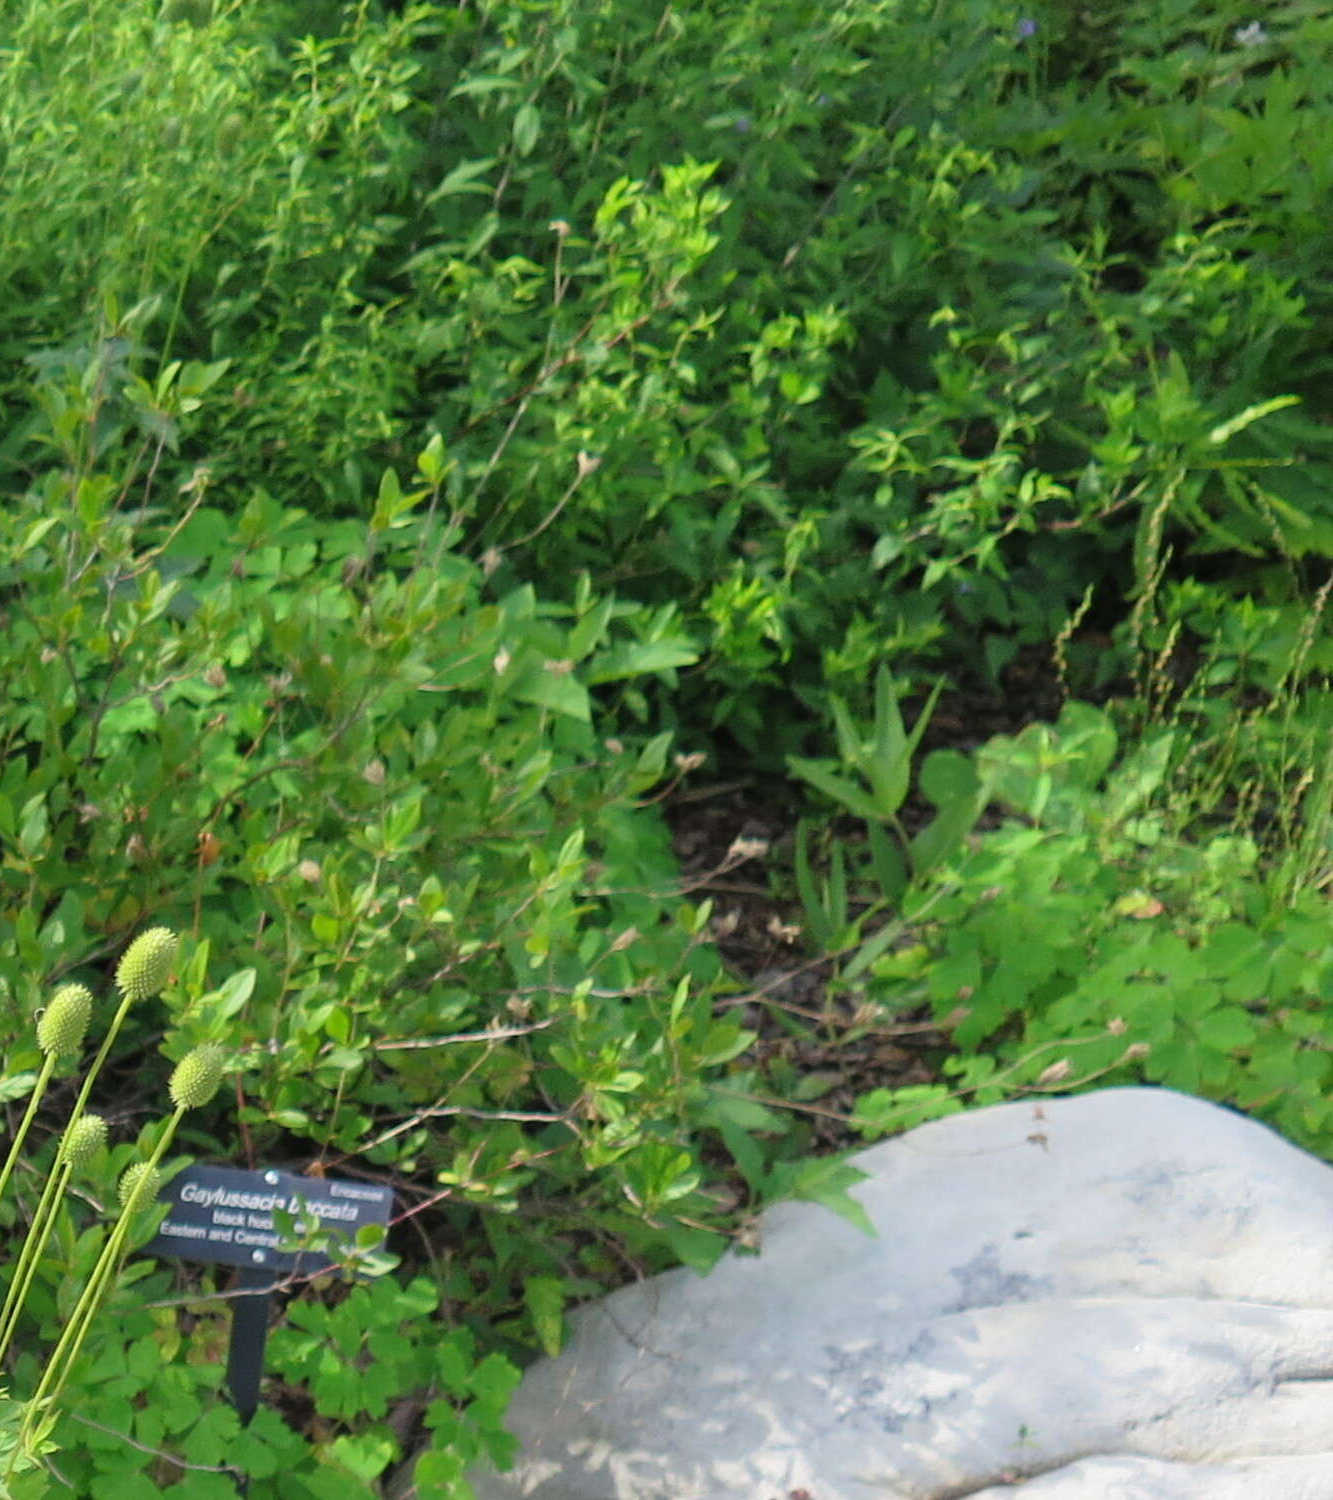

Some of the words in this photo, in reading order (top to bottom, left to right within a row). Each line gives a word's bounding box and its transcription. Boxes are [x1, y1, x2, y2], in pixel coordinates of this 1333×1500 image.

[212, 1208, 246, 1226] black
[288, 1196, 359, 1221] bccata
[160, 1219, 207, 1240] Eastern
[208, 1228, 234, 1242] and
